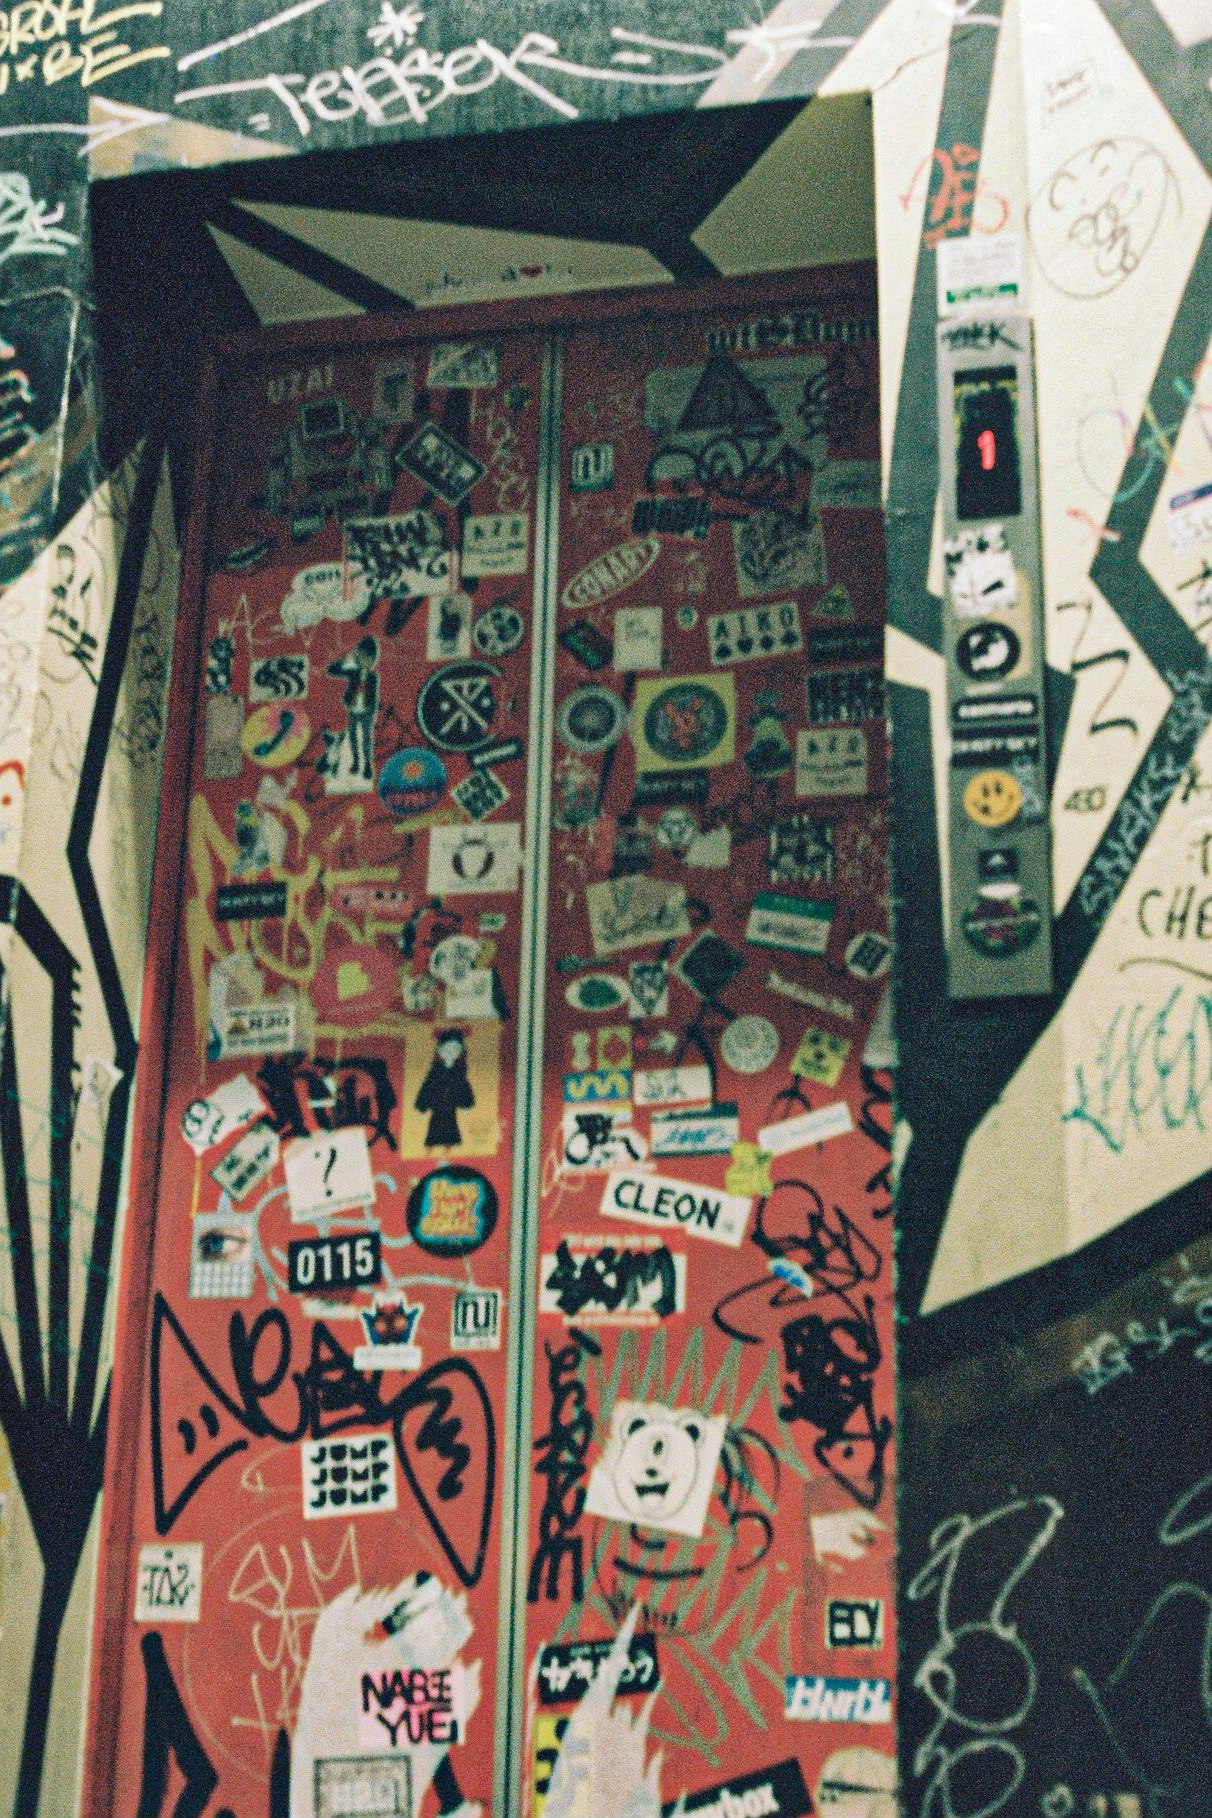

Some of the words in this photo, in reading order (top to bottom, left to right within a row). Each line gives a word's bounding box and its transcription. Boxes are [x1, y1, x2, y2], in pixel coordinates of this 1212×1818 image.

[977, 430, 997, 471] 1
[614, 1179, 721, 1230] CLEON
[296, 1238, 374, 1285] 0115
[310, 1440, 389, 1464] JUMP
[311, 1461, 390, 1486] JUMP
[310, 1484, 389, 1508] JUMP
